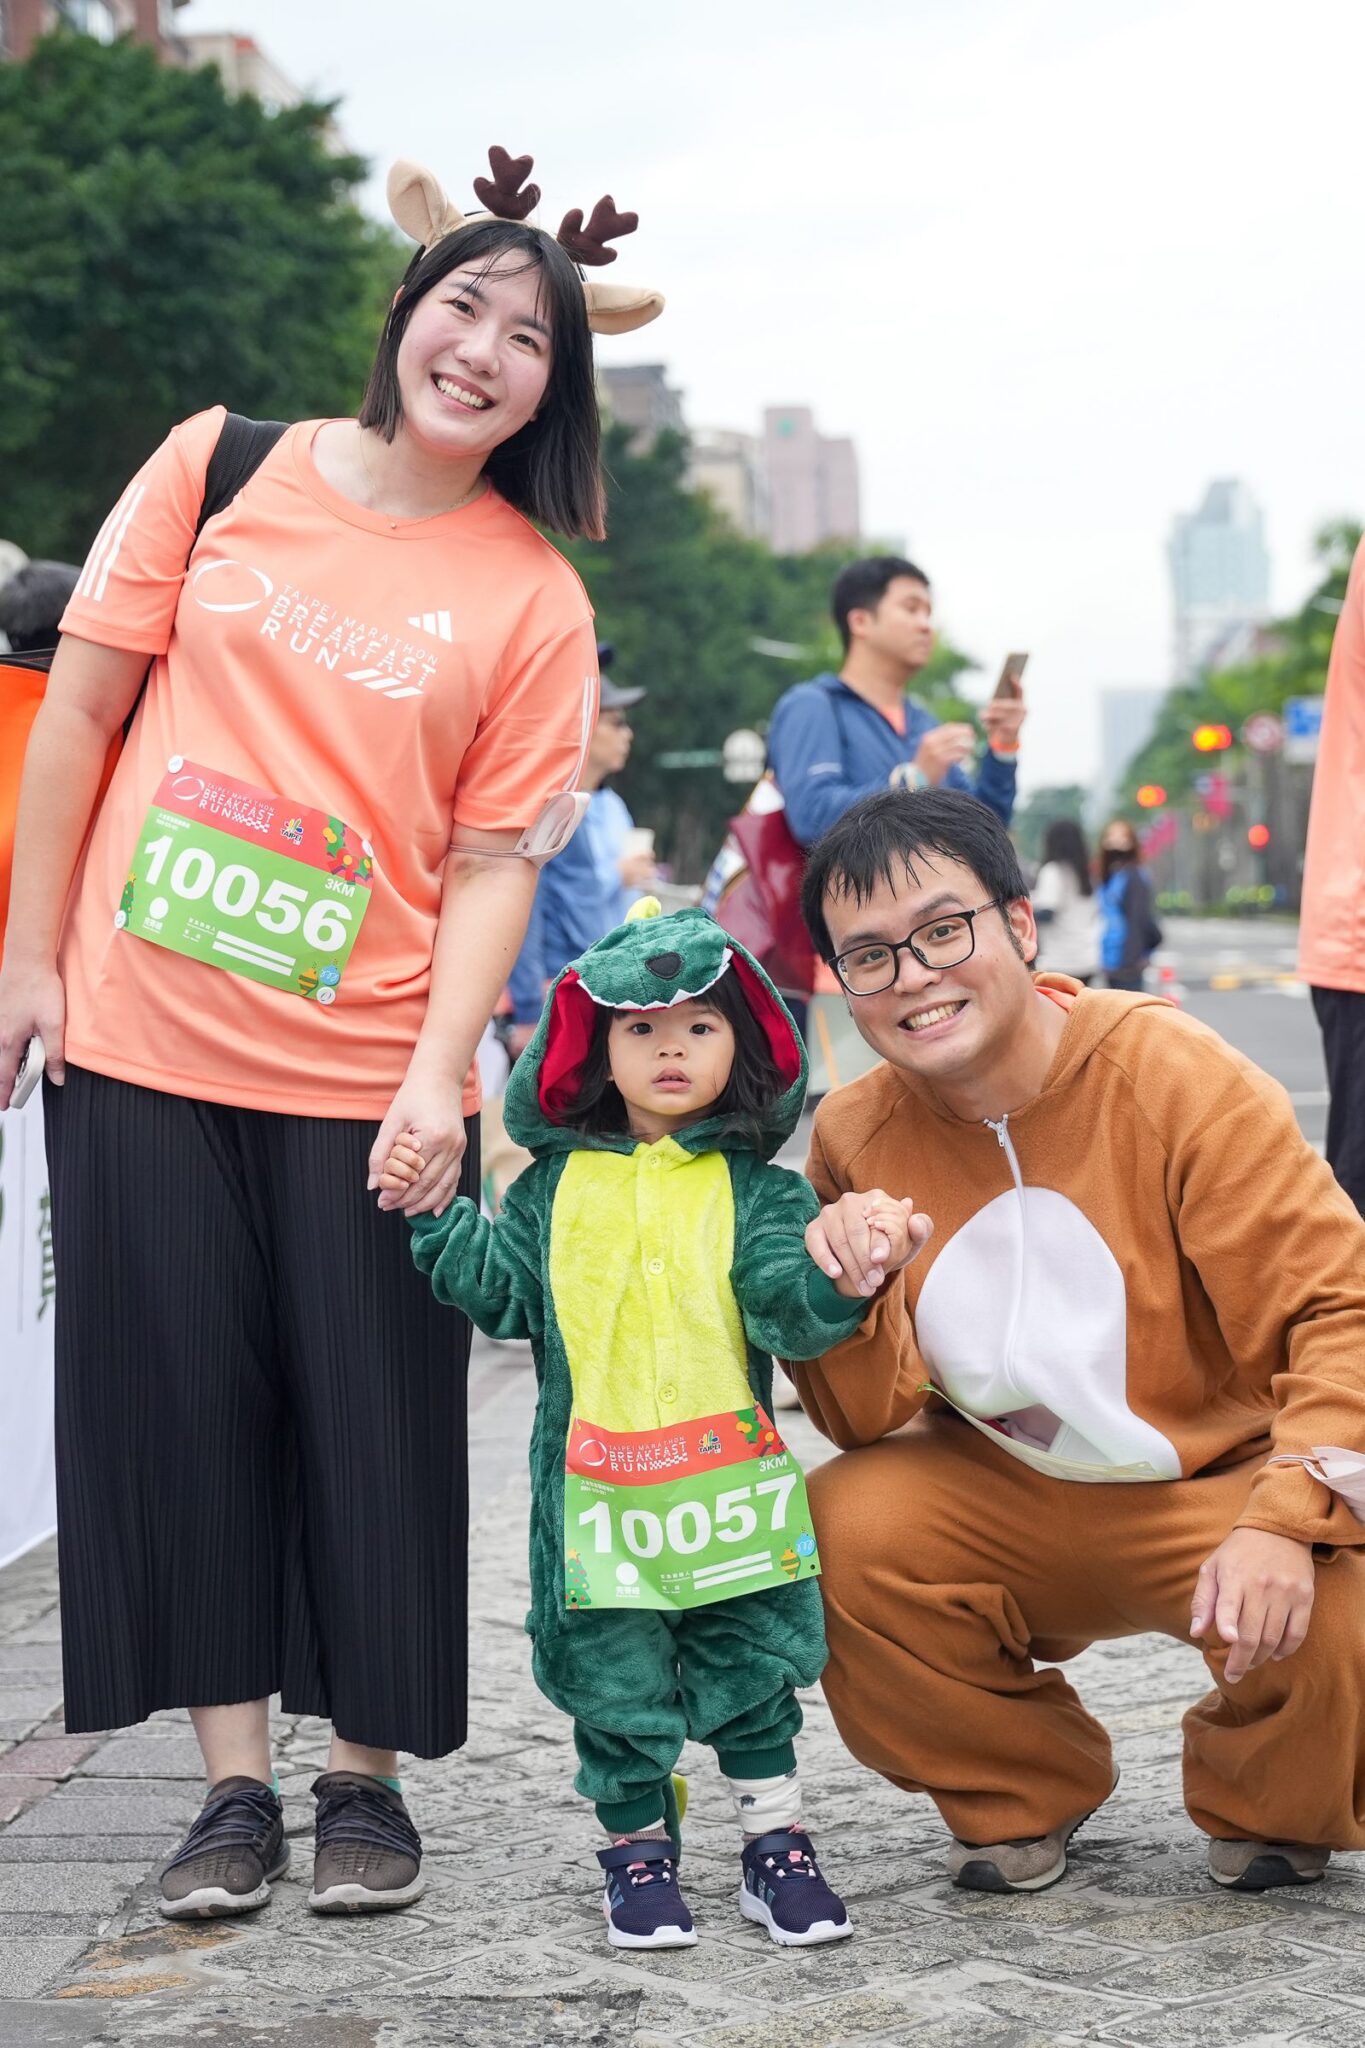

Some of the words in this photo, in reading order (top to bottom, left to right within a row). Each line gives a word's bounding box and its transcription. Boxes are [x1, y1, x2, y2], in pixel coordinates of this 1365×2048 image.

[282, 584, 337, 621] TAIPEI
[342, 618, 439, 666] MARATHON
[259, 619, 341, 671] RUN
[271, 595, 437, 687] BREAKFAST
[199, 799, 232, 819] RUN
[203, 788, 274, 823] BREAKFAST
[280, 829, 303, 842] TAIPEI
[144, 834, 353, 952] 10056
[324, 877, 356, 898] 3KM
[609, 1444, 635, 1452] TAIPEI
[638, 1436, 685, 1451] MARATHON
[609, 1441, 687, 1462] BREAKFAST
[698, 1444, 722, 1453] TAIPEI
[610, 1462, 648, 1472] RUN
[758, 1456, 788, 1473] 3KM
[578, 1472, 798, 1559] 10057
